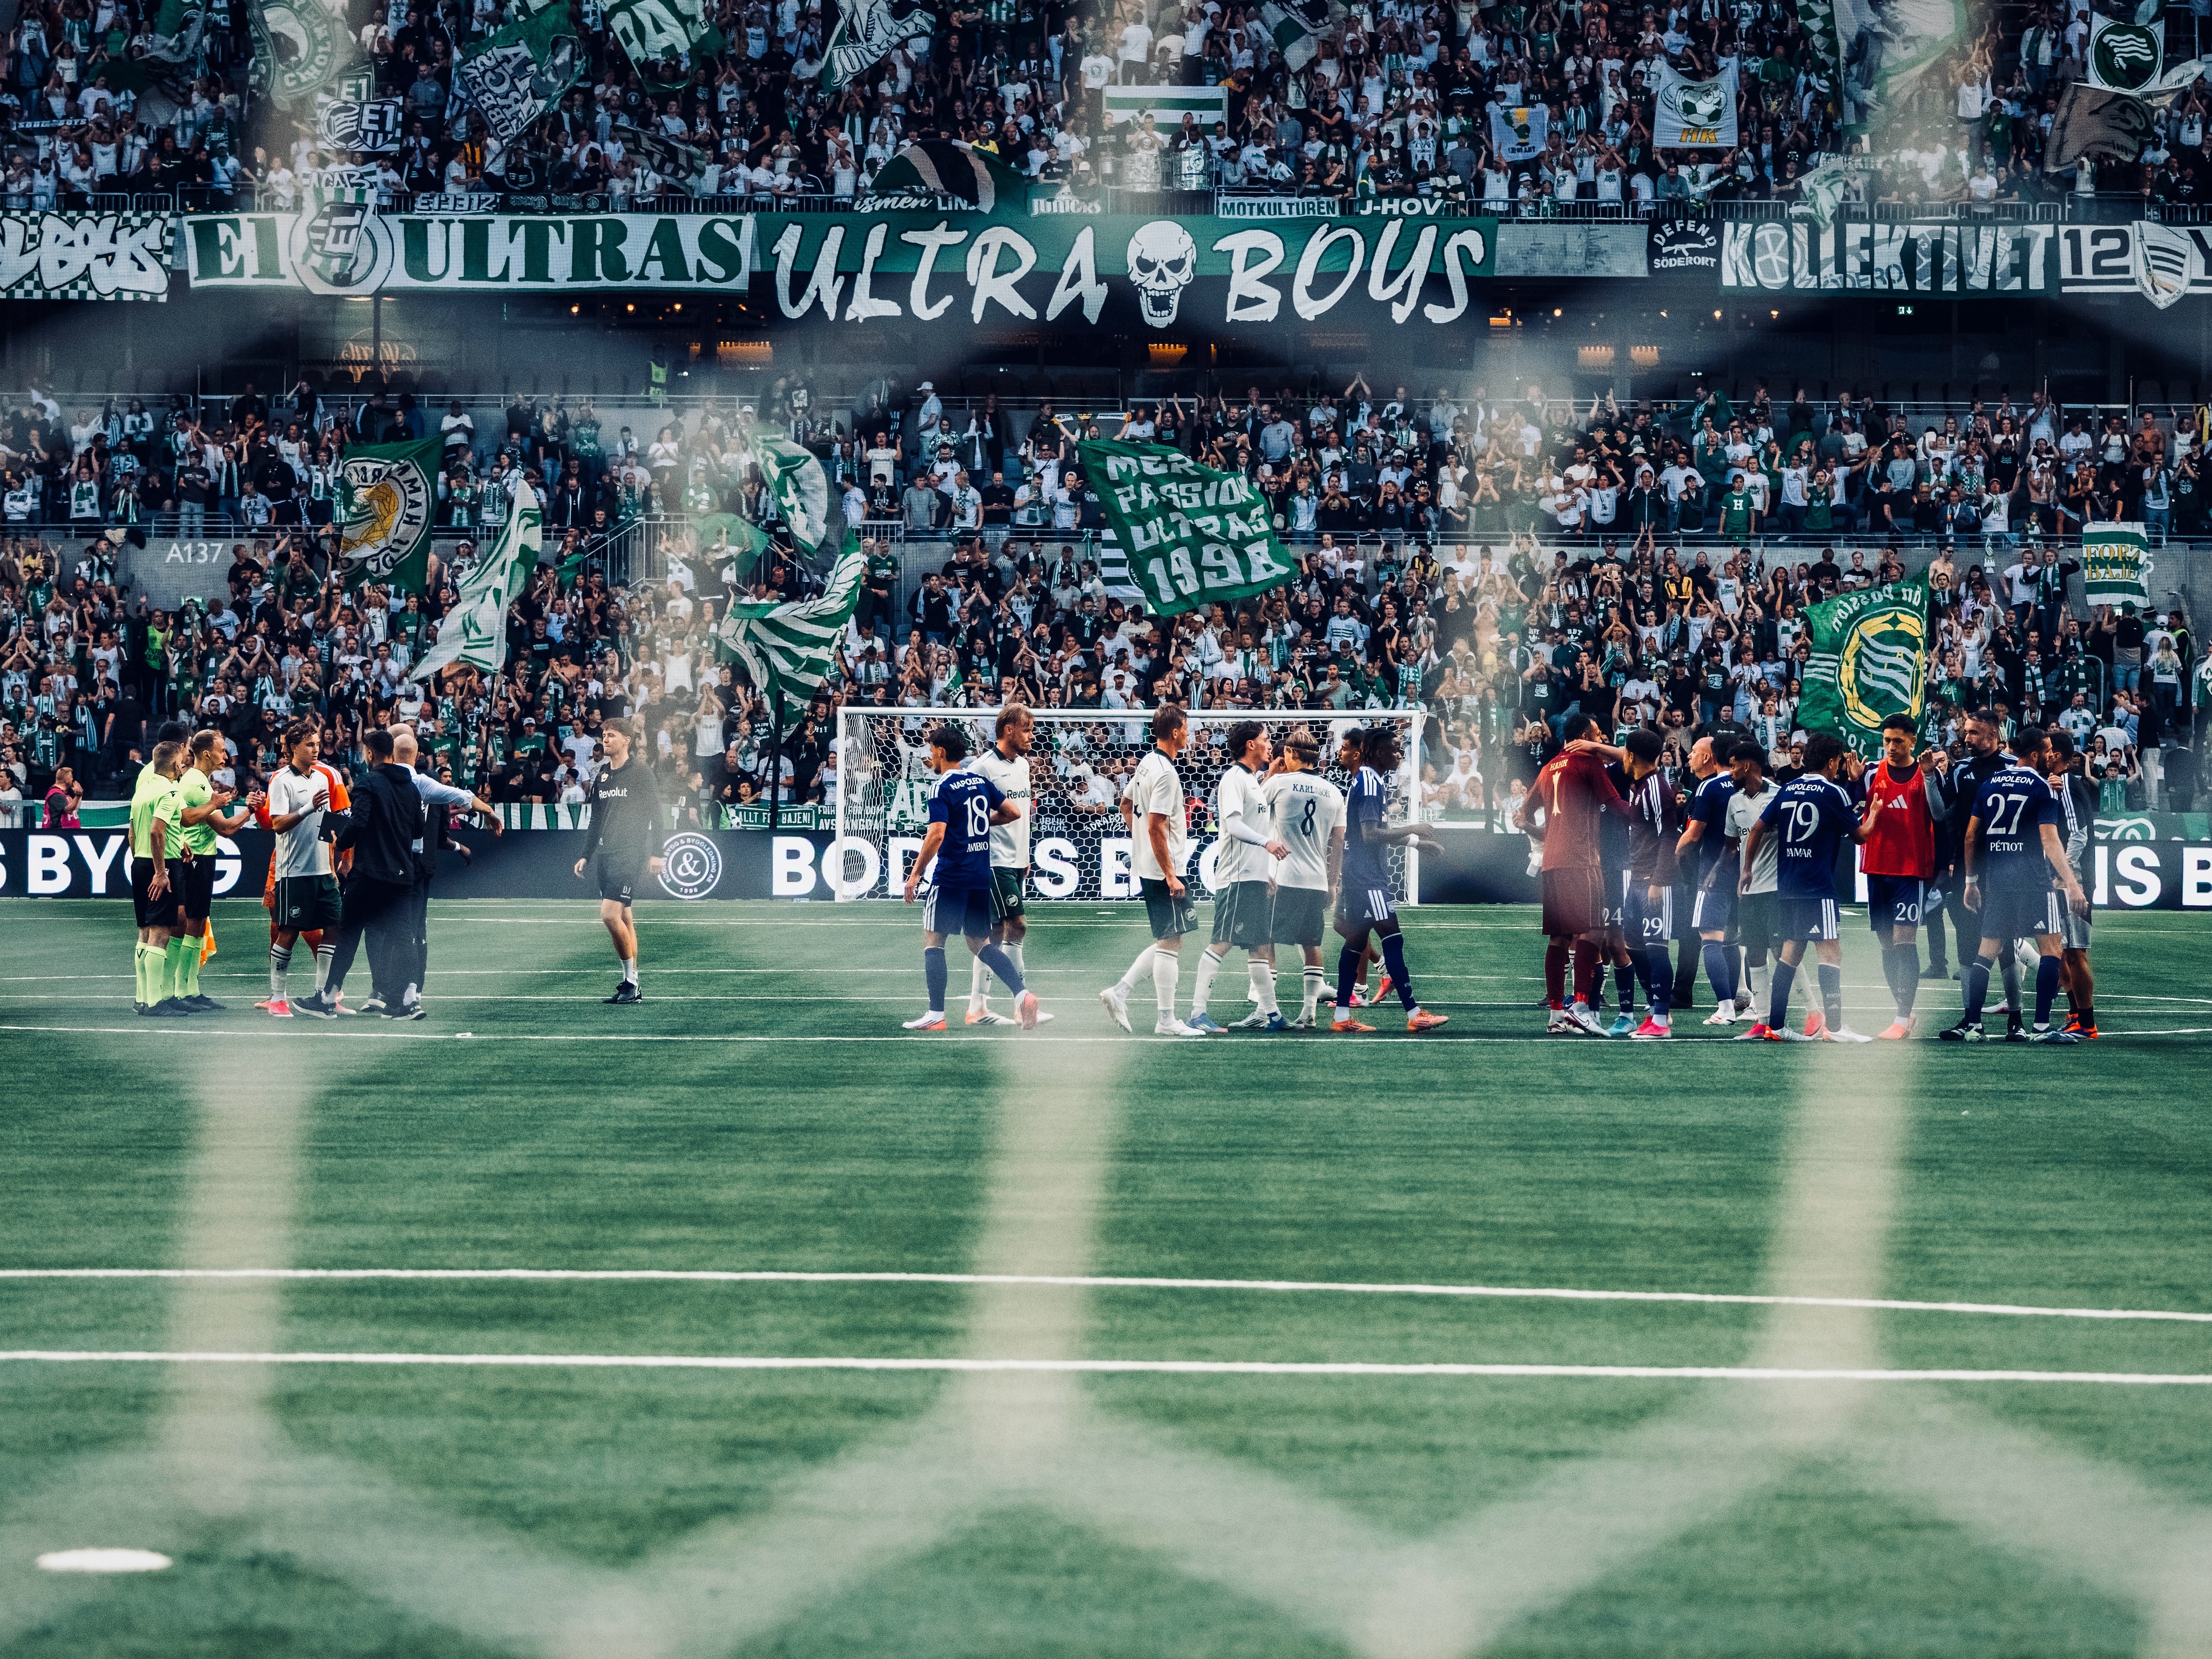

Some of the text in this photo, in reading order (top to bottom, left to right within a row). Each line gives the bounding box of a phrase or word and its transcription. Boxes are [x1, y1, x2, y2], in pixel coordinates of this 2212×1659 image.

[341, 78, 367, 101] E1
[361, 103, 396, 131] E1
[1680, 127, 1722, 143] HK
[1222, 200, 1336, 216] MOTKULTUREN
[1360, 198, 1444, 215] J-HOV
[1653, 220, 1717, 247] DEFEND
[398, 218, 743, 284] ULTRAS
[1722, 222, 2054, 292] KOLLEKTIVET
[2063, 228, 2130, 276] 12
[772, 218, 1485, 325] ULTRA BOYS
[1653, 256, 1717, 268] SÖDERORT
[1106, 453, 1202, 481] MER
[1114, 475, 1255, 514] PASSION
[1734, 499, 1744, 511] H
[1130, 504, 1270, 552] ULTRAS
[165, 542, 224, 564] A137
[2084, 544, 2140, 563] FORZ
[1147, 538, 1290, 604] 1998
[2087, 564, 2139, 581] BAJE
[1549, 758, 1568, 772] HAHN
[949, 777, 986, 791] NAPOLEON
[1292, 783, 1331, 798] KARLSSON
[1785, 783, 1825, 794] NAPOLEON
[1990, 775, 2035, 786] NAPOLEON
[598, 787, 628, 800] Revolut
[1006, 789, 1030, 800] Revolu
[1552, 770, 1562, 817] 1
[739, 811, 758, 824] ALLT
[781, 811, 811, 824] BAJEN!
[963, 795, 989, 837] 18
[1300, 798, 1317, 838] 8
[1780, 800, 1819, 843] 79
[1986, 793, 2029, 835] 27
[27, 834, 242, 895] BYG
[623, 885, 631, 894] DJ
[1894, 902, 1918, 922] 20
[1642, 918, 1664, 937] 29
